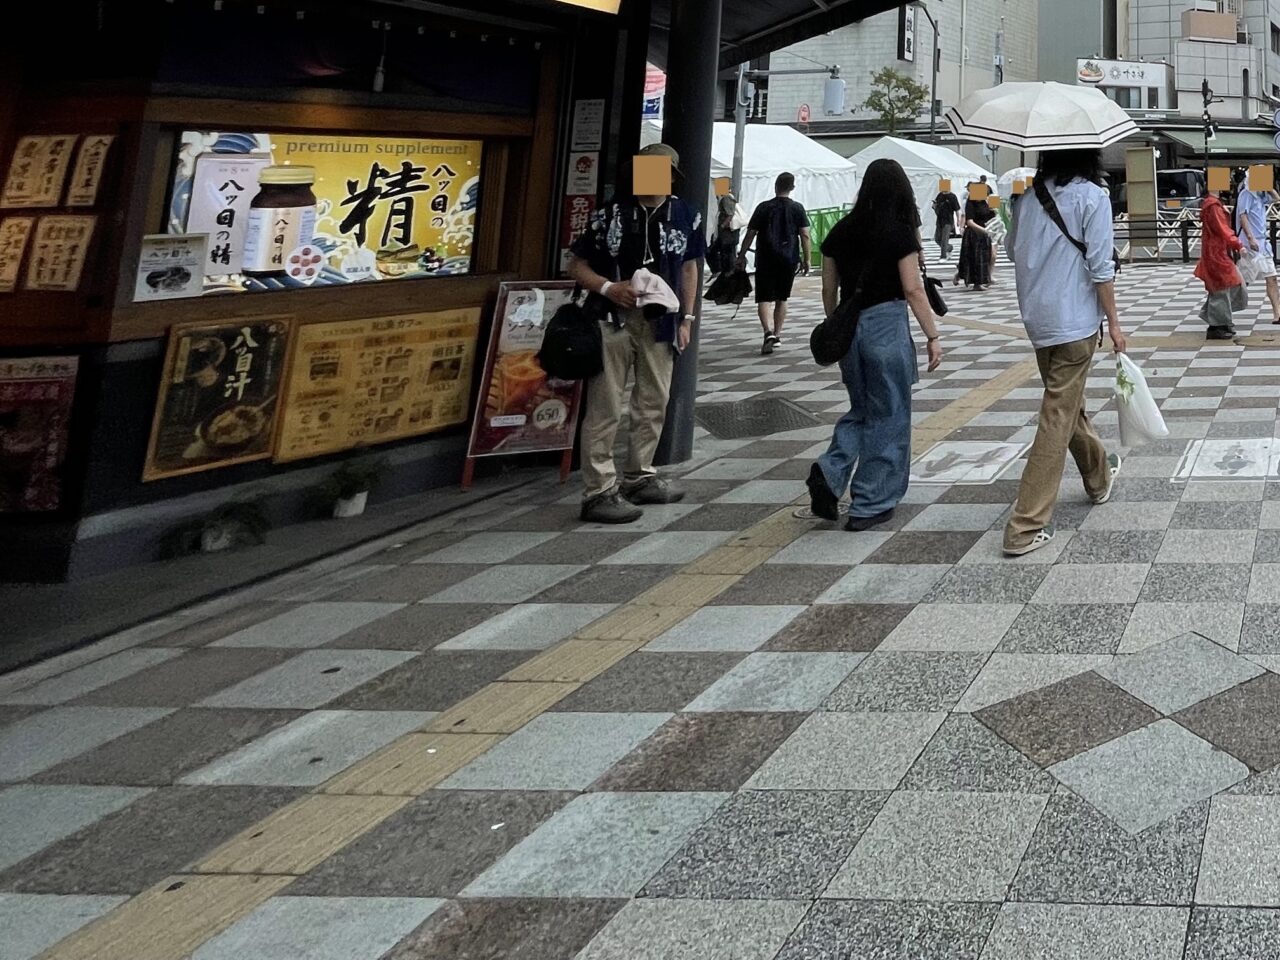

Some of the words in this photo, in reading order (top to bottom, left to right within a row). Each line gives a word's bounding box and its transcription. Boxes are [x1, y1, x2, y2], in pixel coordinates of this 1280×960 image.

[286, 141, 369, 156] premium
[375, 142, 467, 157] supplement
[339, 161, 430, 248] 精
